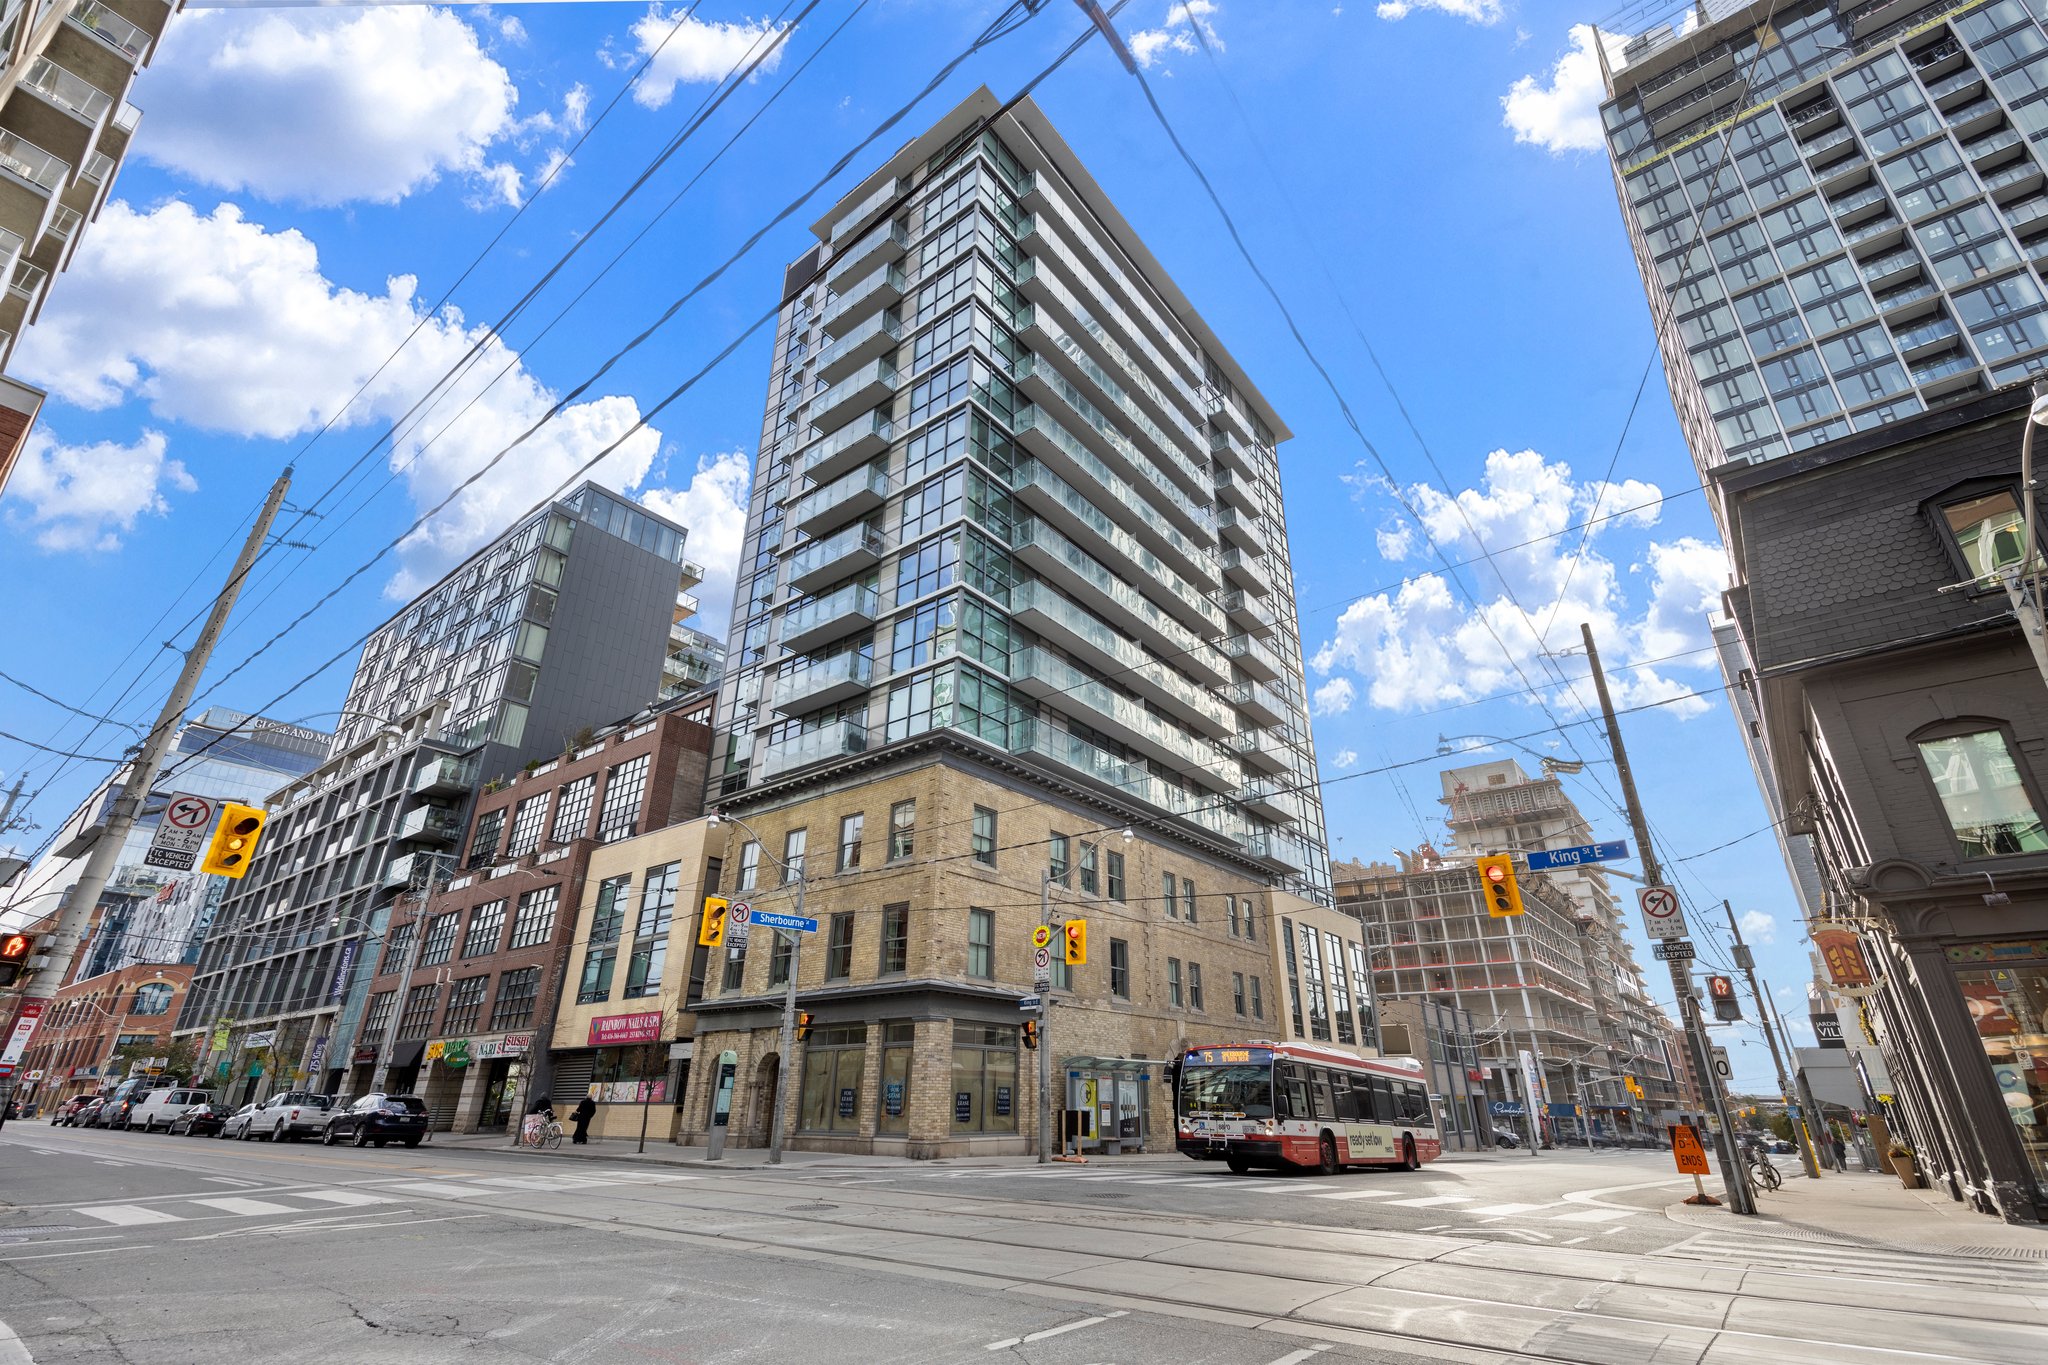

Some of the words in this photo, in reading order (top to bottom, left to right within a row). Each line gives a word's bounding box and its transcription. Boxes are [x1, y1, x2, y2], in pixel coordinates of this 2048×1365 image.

[290, 727, 314, 740] AND
[314, 734, 332, 746] MA
[165, 852, 195, 861] VEHICLES
[1549, 851, 1580, 864] King
[1594, 846, 1604, 858] E
[148, 857, 190, 869] EXCEPTED
[760, 914, 804, 927] Sherbourne
[1656, 950, 1693, 959] EXCEPTED
[333, 947, 352, 997] Waddingtons.ca
[601, 1018, 627, 1031] RAINBOW
[627, 1017, 643, 1029] NAILS
[648, 1016, 659, 1027] SPA
[1817, 1027, 1843, 1036] VILL
[506, 1036, 530, 1046] SUSHI
[312, 1044, 326, 1060] King
[479, 1043, 496, 1056] NARI
[1204, 1052, 1214, 1062] 75
[309, 1060, 320, 1072] 275
[1350, 1131, 1364, 1149] ready
[1372, 1131, 1382, 1146] low
[1678, 1140, 1696, 1149] D-1
[1681, 1155, 1702, 1166] ENDS
